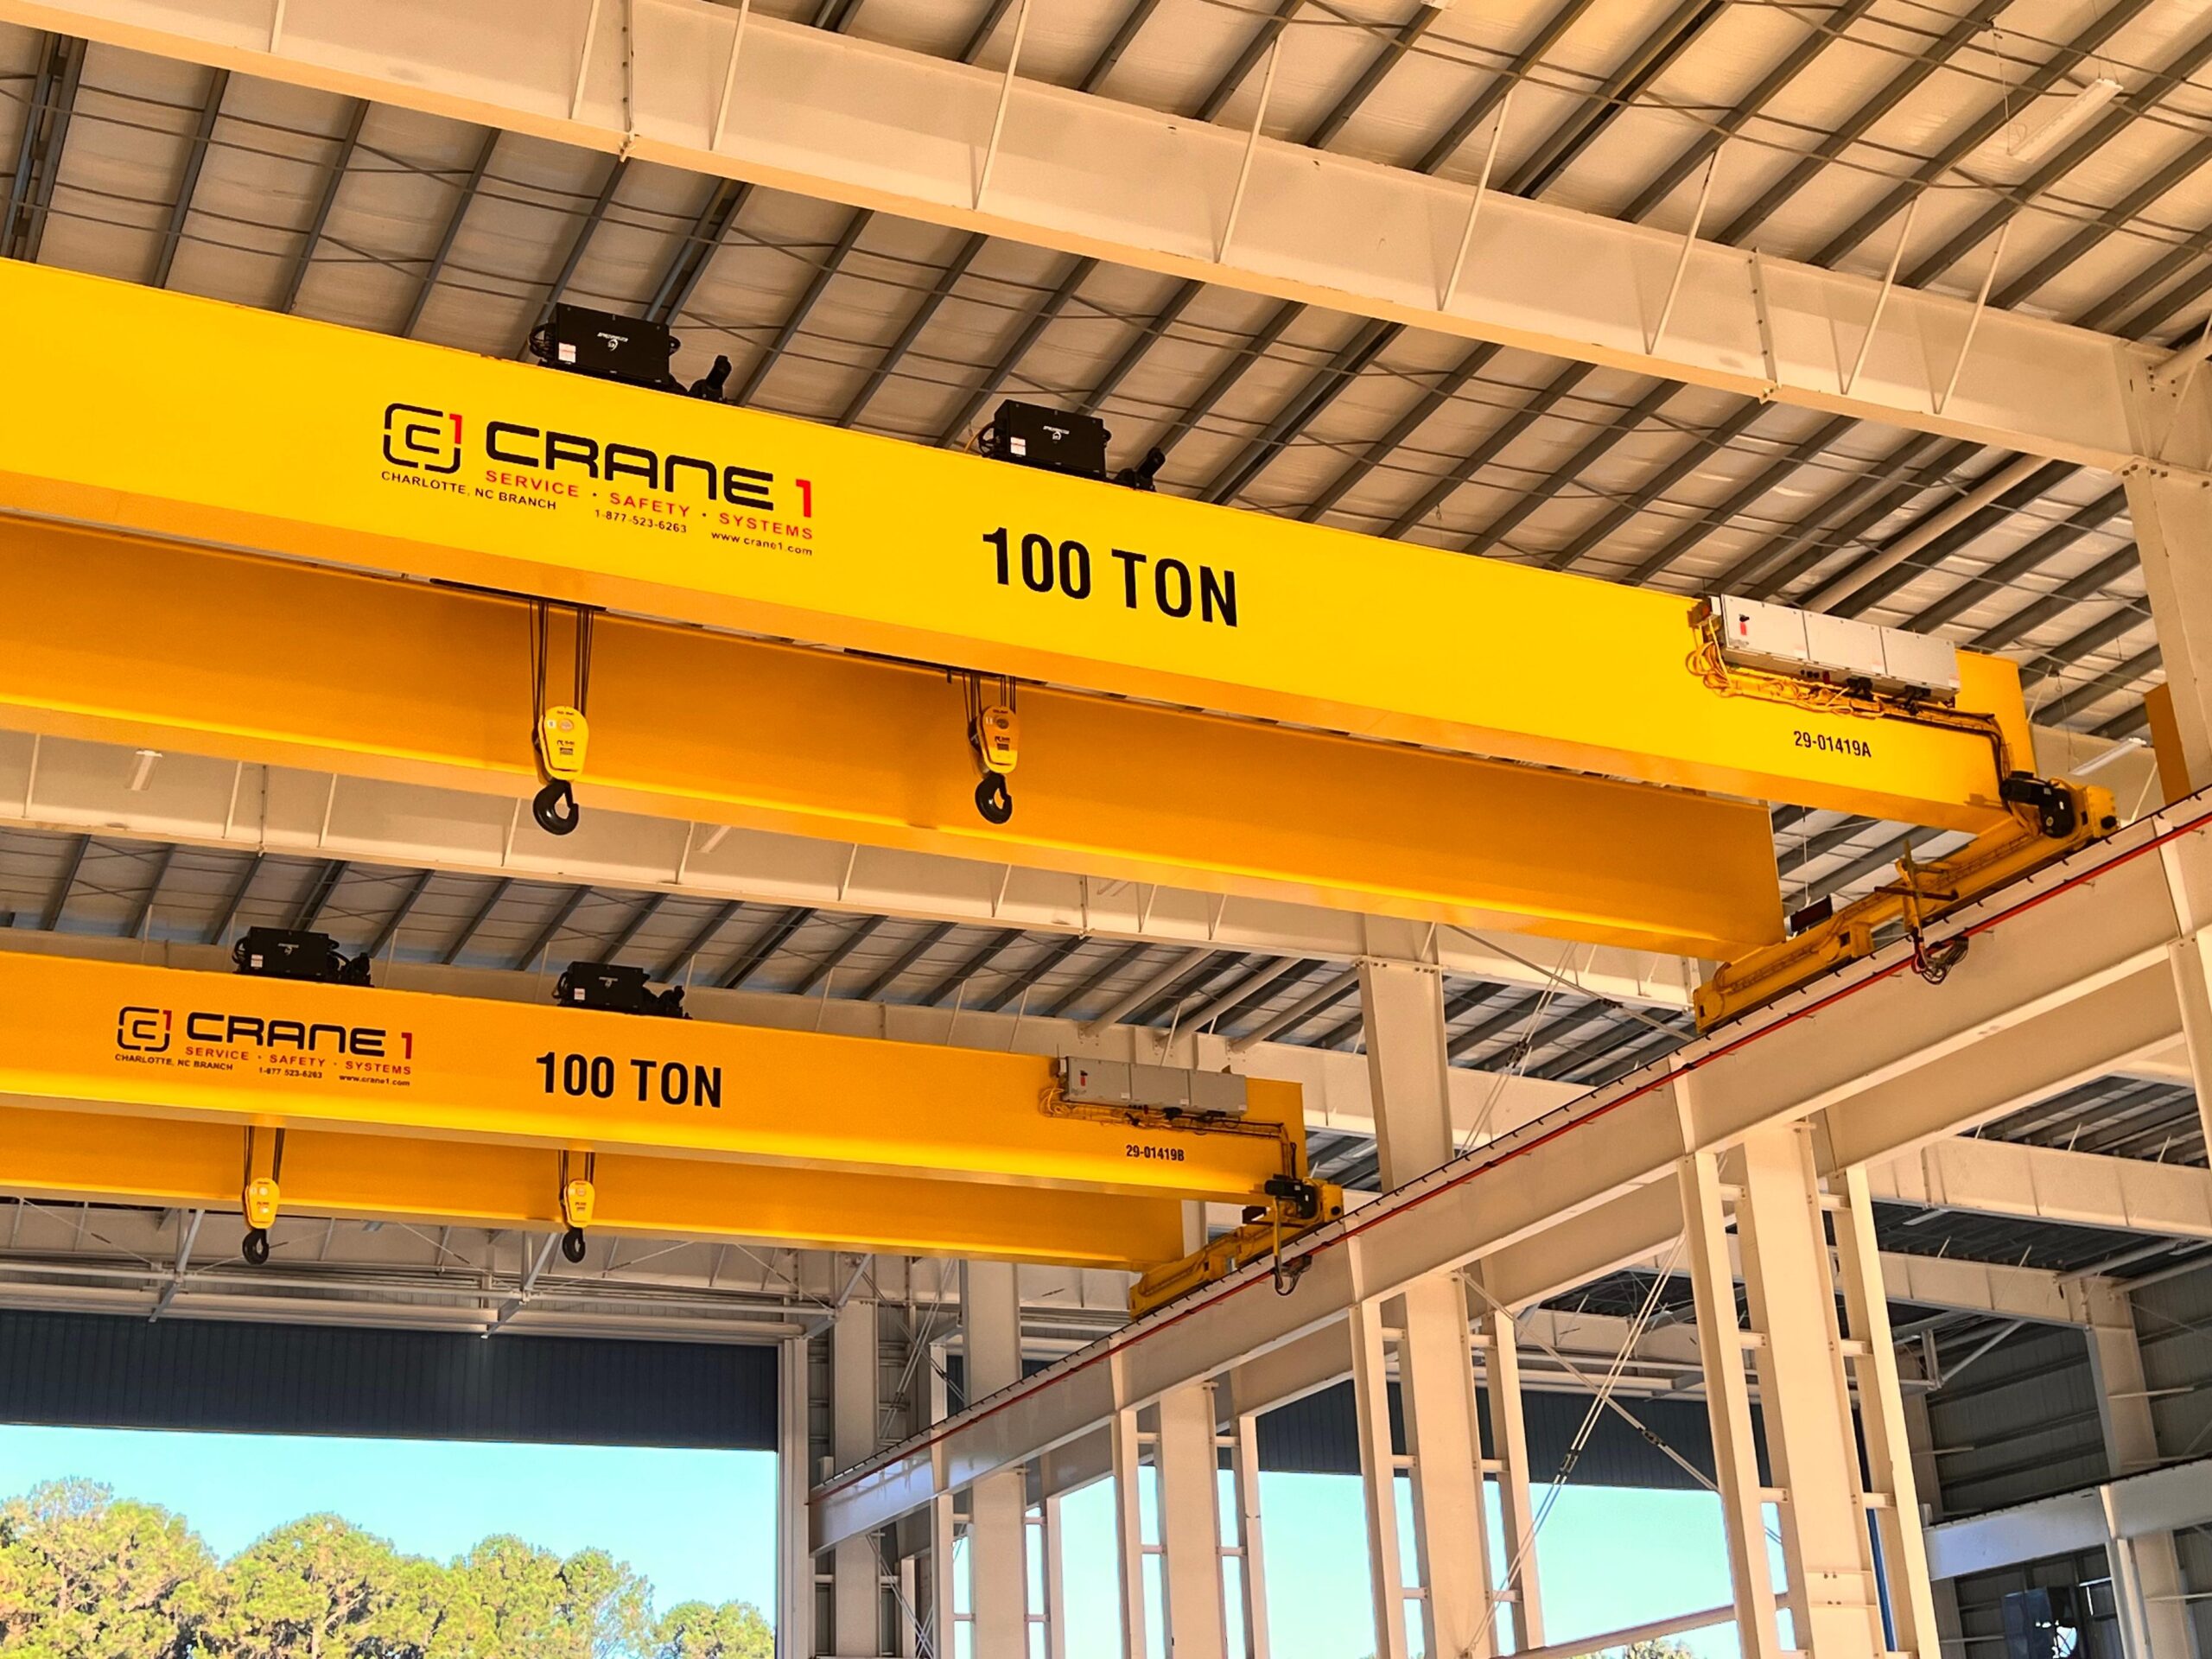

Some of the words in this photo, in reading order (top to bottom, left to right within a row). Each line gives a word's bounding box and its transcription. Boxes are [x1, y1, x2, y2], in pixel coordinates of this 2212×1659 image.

[485, 420, 774, 512] CRANE
[795, 478, 812, 518] 1
[381, 470, 470, 497] CHARLOTTE,
[474, 487, 494, 499] NC
[498, 491, 556, 511] BRANCH
[485, 469, 580, 498] SERVICE
[609, 492, 690, 518] SAFETY
[719, 512, 814, 540] SYSTEMS
[594, 508, 688, 534] 1-877-523-6263
[710, 531, 814, 557] wwwcrane1.com
[982, 526, 1091, 600] 100
[1110, 548, 1237, 628] TON
[1793, 730, 1872, 758] 29-01419A
[186, 1011, 387, 1058] CRANE
[401, 1032, 413, 1060] 1
[177, 1058, 191, 1067] NC
[193, 1060, 233, 1071] BRANCH
[185, 1046, 250, 1061] SERVICE
[269, 1053, 326, 1067] SAFETY
[345, 1060, 412, 1076] SYSTEMS
[258, 1066, 323, 1079] 1-877523-6263
[338, 1074, 411, 1087] www.crane1com
[536, 1052, 614, 1099] 100
[630, 1059, 721, 1109] TON
[1126, 1144, 1185, 1161] 29-01419B
